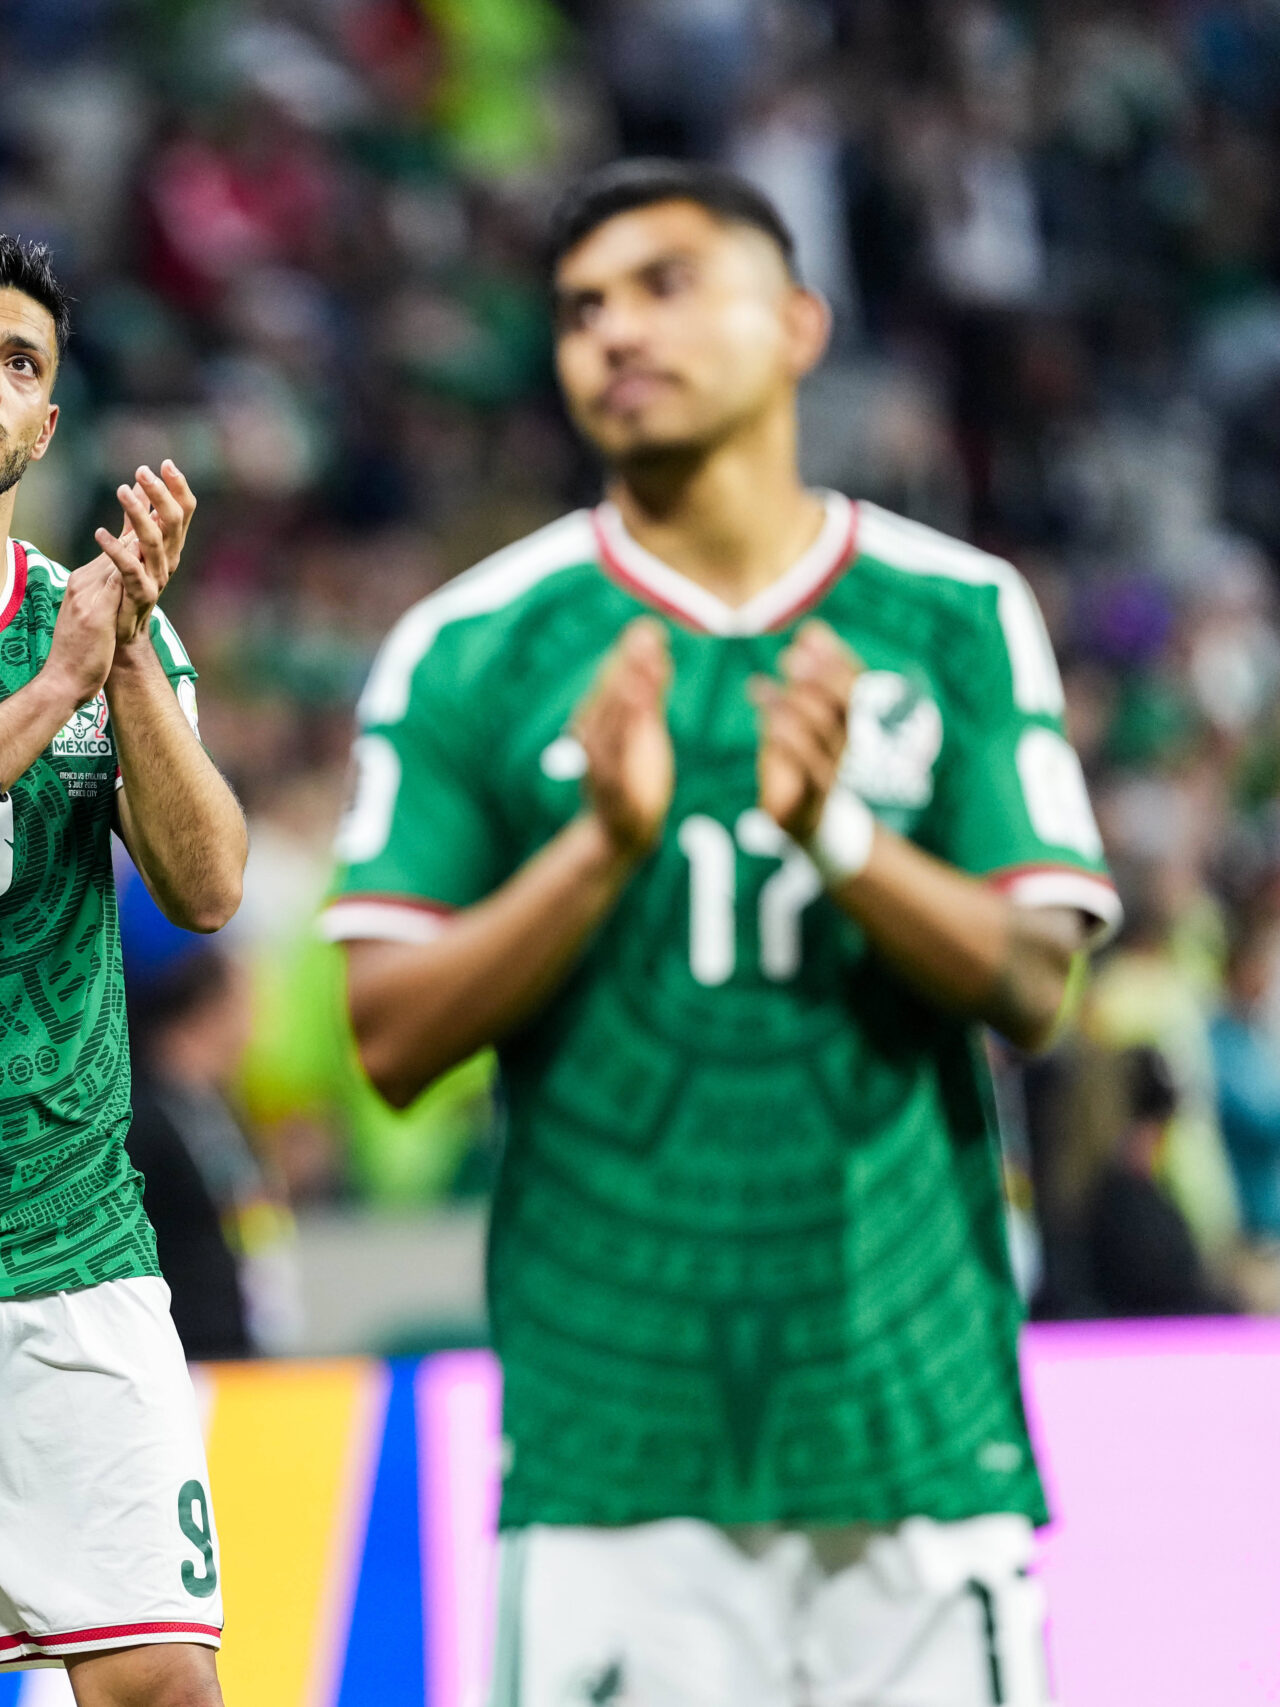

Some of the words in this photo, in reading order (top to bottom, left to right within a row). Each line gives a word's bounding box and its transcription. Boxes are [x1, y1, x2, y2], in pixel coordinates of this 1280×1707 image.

[54, 737, 109, 754] MÉXICO
[677, 808, 823, 987] 17
[177, 1479, 217, 1598] 9
